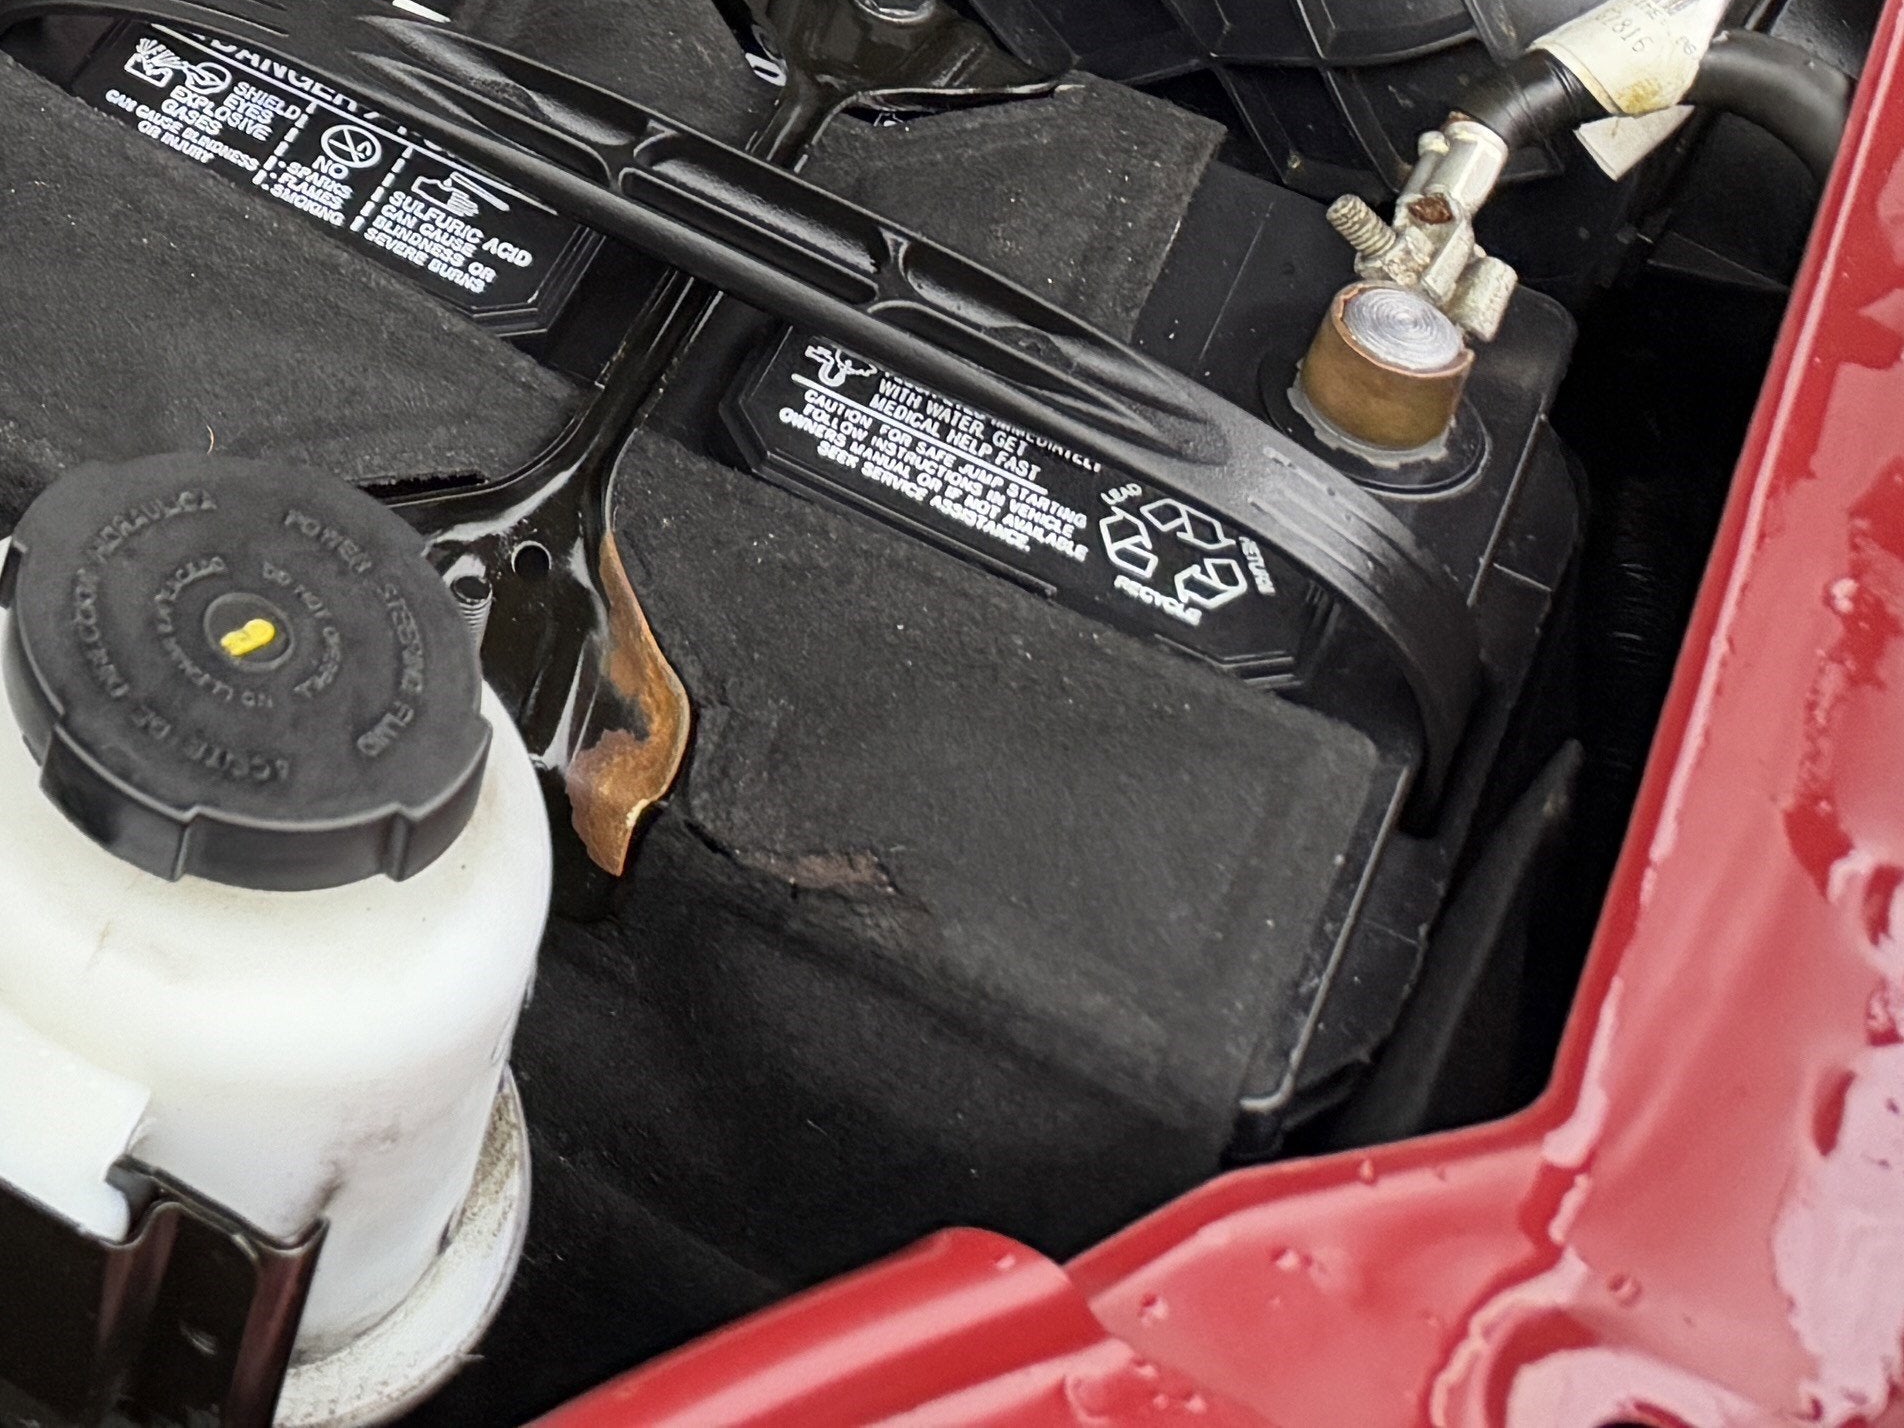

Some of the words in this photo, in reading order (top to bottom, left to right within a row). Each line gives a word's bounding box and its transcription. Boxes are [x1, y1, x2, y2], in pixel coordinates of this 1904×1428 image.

[161, 99, 222, 136] GASES
[170, 85, 274, 141] EXPLOSIVE
[223, 93, 274, 125] EYES
[233, 81, 301, 120] SHIELD
[105, 89, 138, 112] CAN
[135, 104, 184, 135] CAUSE
[182, 127, 260, 171] BLINDNESS
[138, 120, 162, 139] OR
[161, 132, 215, 164] INJURY
[278, 173, 345, 211] FLAMES
[286, 161, 354, 200] SPARKS
[312, 155, 349, 180] NO
[270, 184, 346, 227] SMOKING
[380, 205, 416, 230] CAN
[419, 222, 477, 259] CAUSE
[389, 191, 484, 244] SULFURIC
[482, 237, 532, 268] ACID
[363, 227, 428, 267] SEVERE
[428, 259, 485, 294] BURNS
[372, 215, 465, 268] BLINDNESS
[468, 261, 498, 283] OR
[869, 393, 940, 438] MEDICAL
[946, 429, 993, 457] HELP
[995, 450, 1042, 481] FAST
[878, 378, 923, 409] WITH
[993, 431, 1028, 456] GET
[803, 403, 868, 441] FOLLOW
[871, 436, 983, 497] INSTRUCTIONS
[986, 490, 1006, 507] IN
[1009, 499, 1074, 539] VEHICLE
[804, 389, 873, 429] CAUTION
[880, 424, 913, 448] FOR
[916, 441, 957, 468] SAFE
[959, 463, 1005, 488] JUMP
[1006, 483, 1087, 529] STARTING
[817, 440, 859, 468] SEEK
[861, 461, 928, 501] SERVICE
[850, 442, 910, 479] MANUAL
[917, 473, 942, 492] OR
[944, 485, 963, 499] IF
[964, 494, 1001, 518] NOT
[1002, 514, 1089, 562] AVAILABLE
[1100, 483, 1142, 505] LEAD
[1114, 575, 1202, 626] RECYCLE
[284, 509, 372, 573] POWER
[357, 701, 414, 758] FLUID
